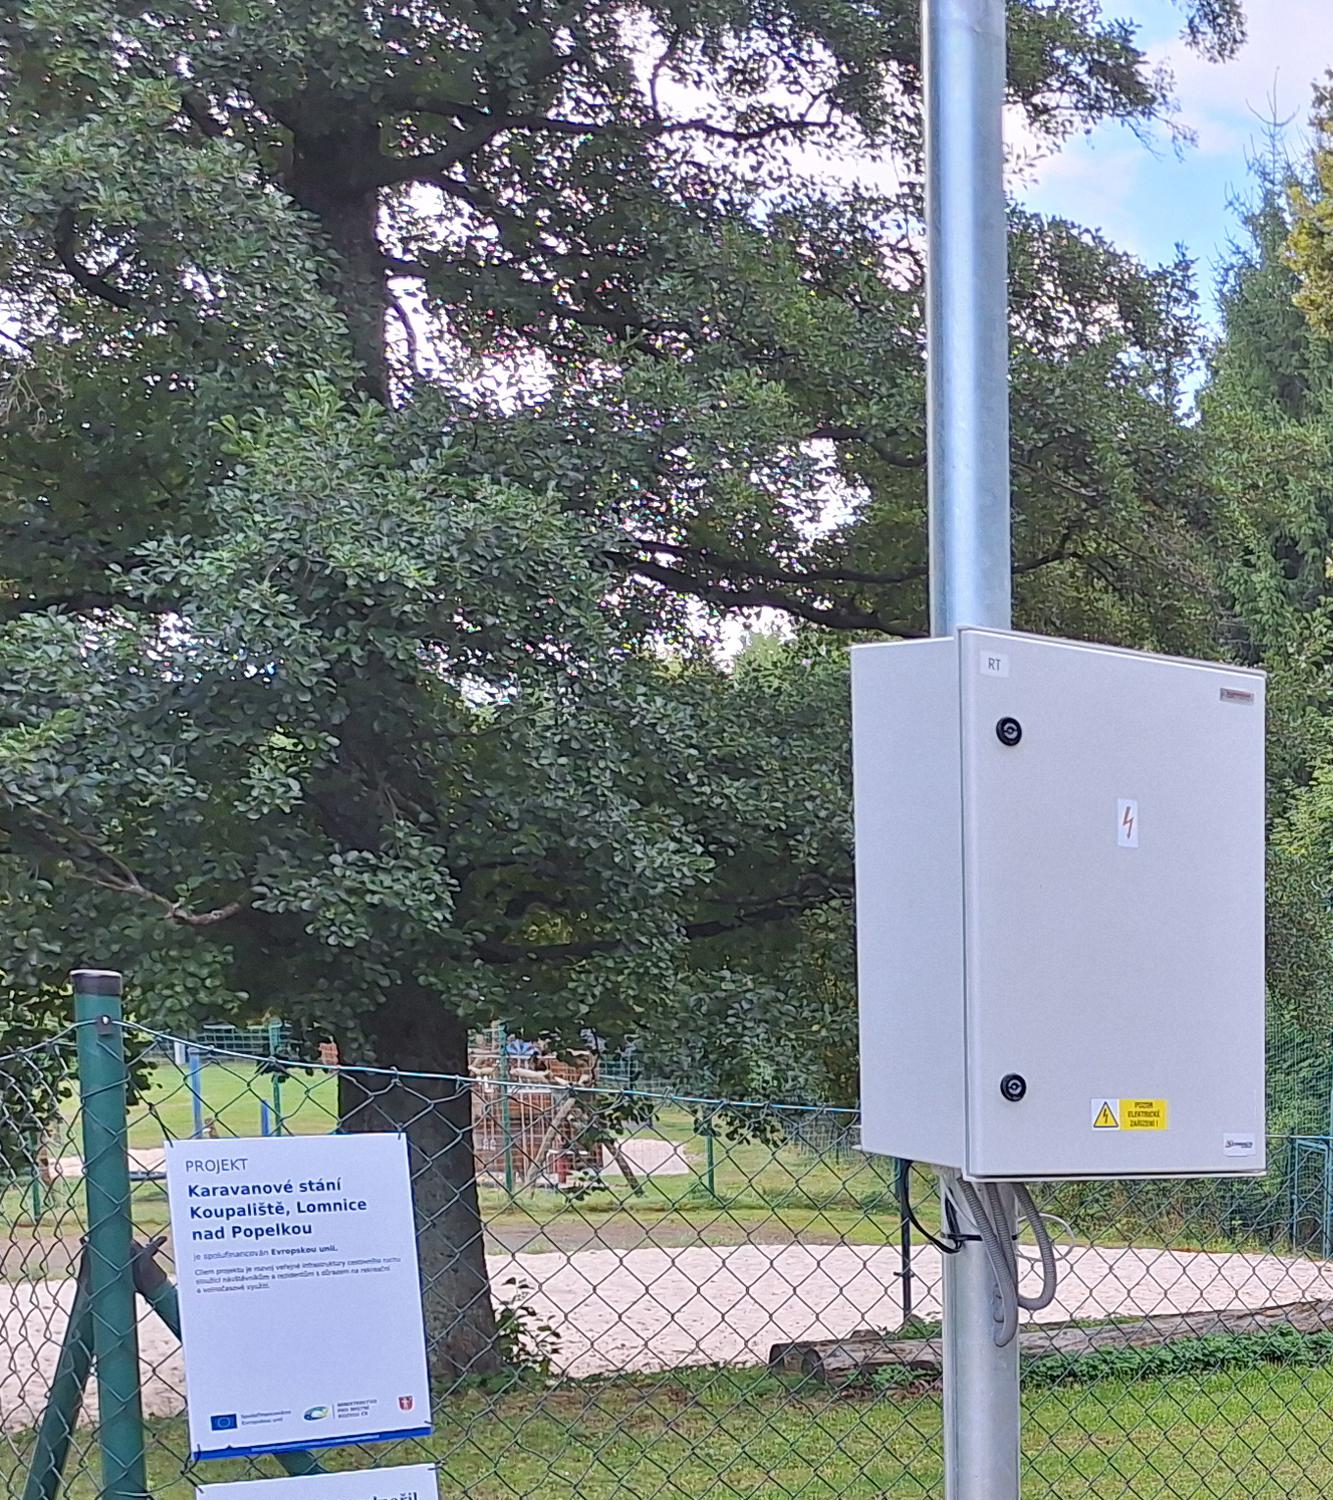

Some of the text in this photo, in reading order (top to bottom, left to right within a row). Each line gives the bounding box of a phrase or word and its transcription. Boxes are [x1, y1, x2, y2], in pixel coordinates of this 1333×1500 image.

[185, 1158, 248, 1174] PROJEKT
[188, 1177, 341, 1197] Karavanové stání
[190, 1198, 367, 1221] Koupaliště, Lomnice
[192, 1223, 312, 1241] nad Popelkou
